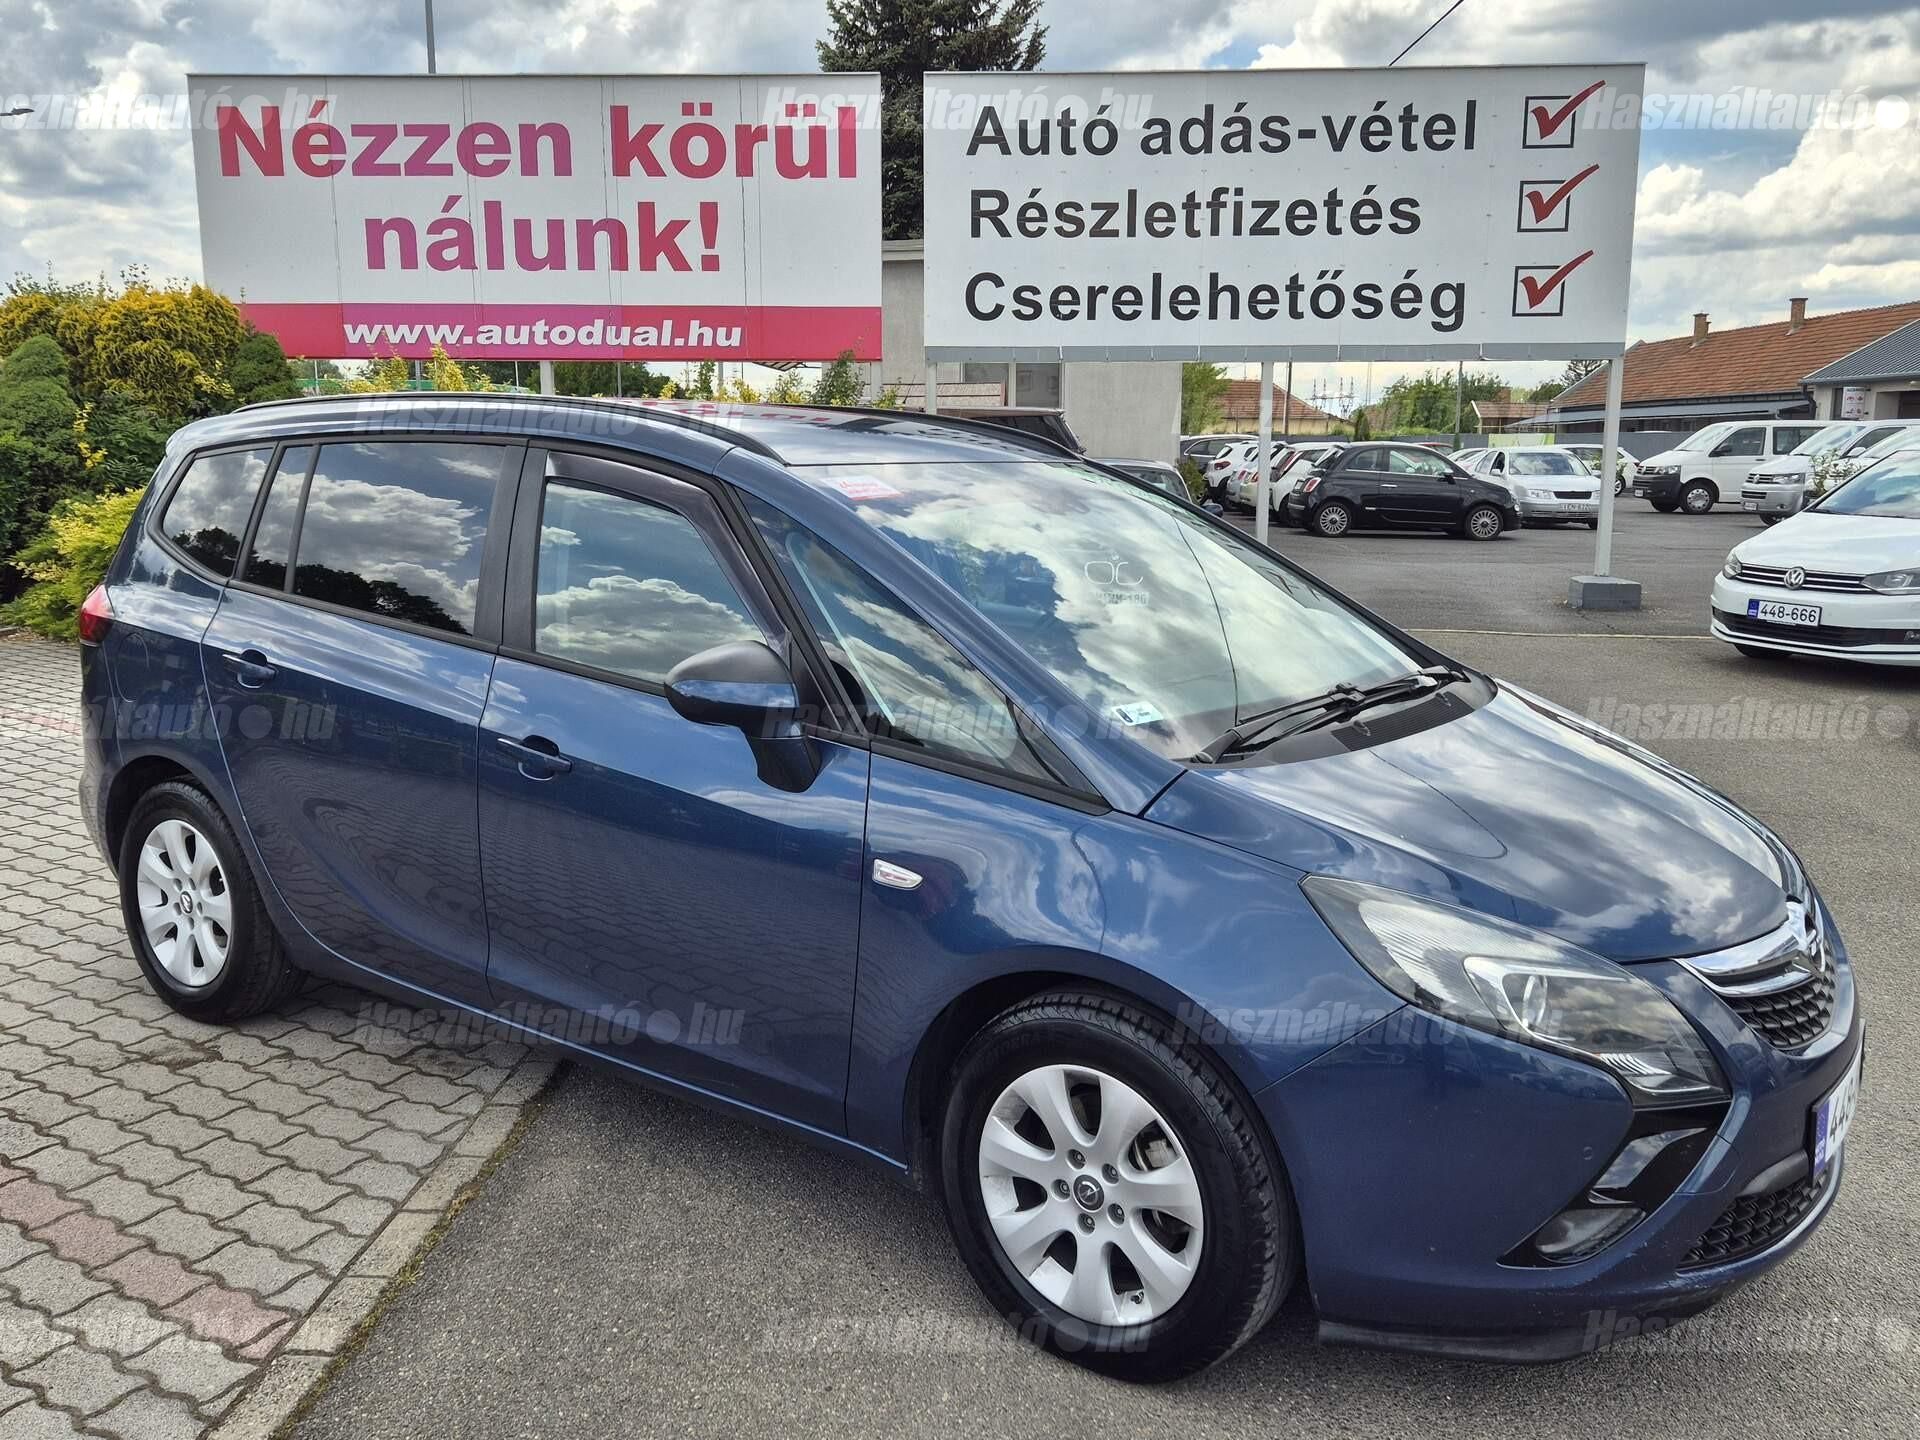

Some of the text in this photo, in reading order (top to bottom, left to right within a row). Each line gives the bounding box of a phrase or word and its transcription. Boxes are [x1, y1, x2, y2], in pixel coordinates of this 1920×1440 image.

[217, 100, 857, 179] Nézzen körül
[966, 100, 1476, 156] Autó adás-vétel
[365, 195, 720, 273] nálunk!
[970, 185, 1421, 238] Részletfizetés
[965, 269, 1466, 332] Cserelehetőség
[343, 319, 742, 347] www.autodual.hu
[1760, 603, 1817, 623] 448-666
